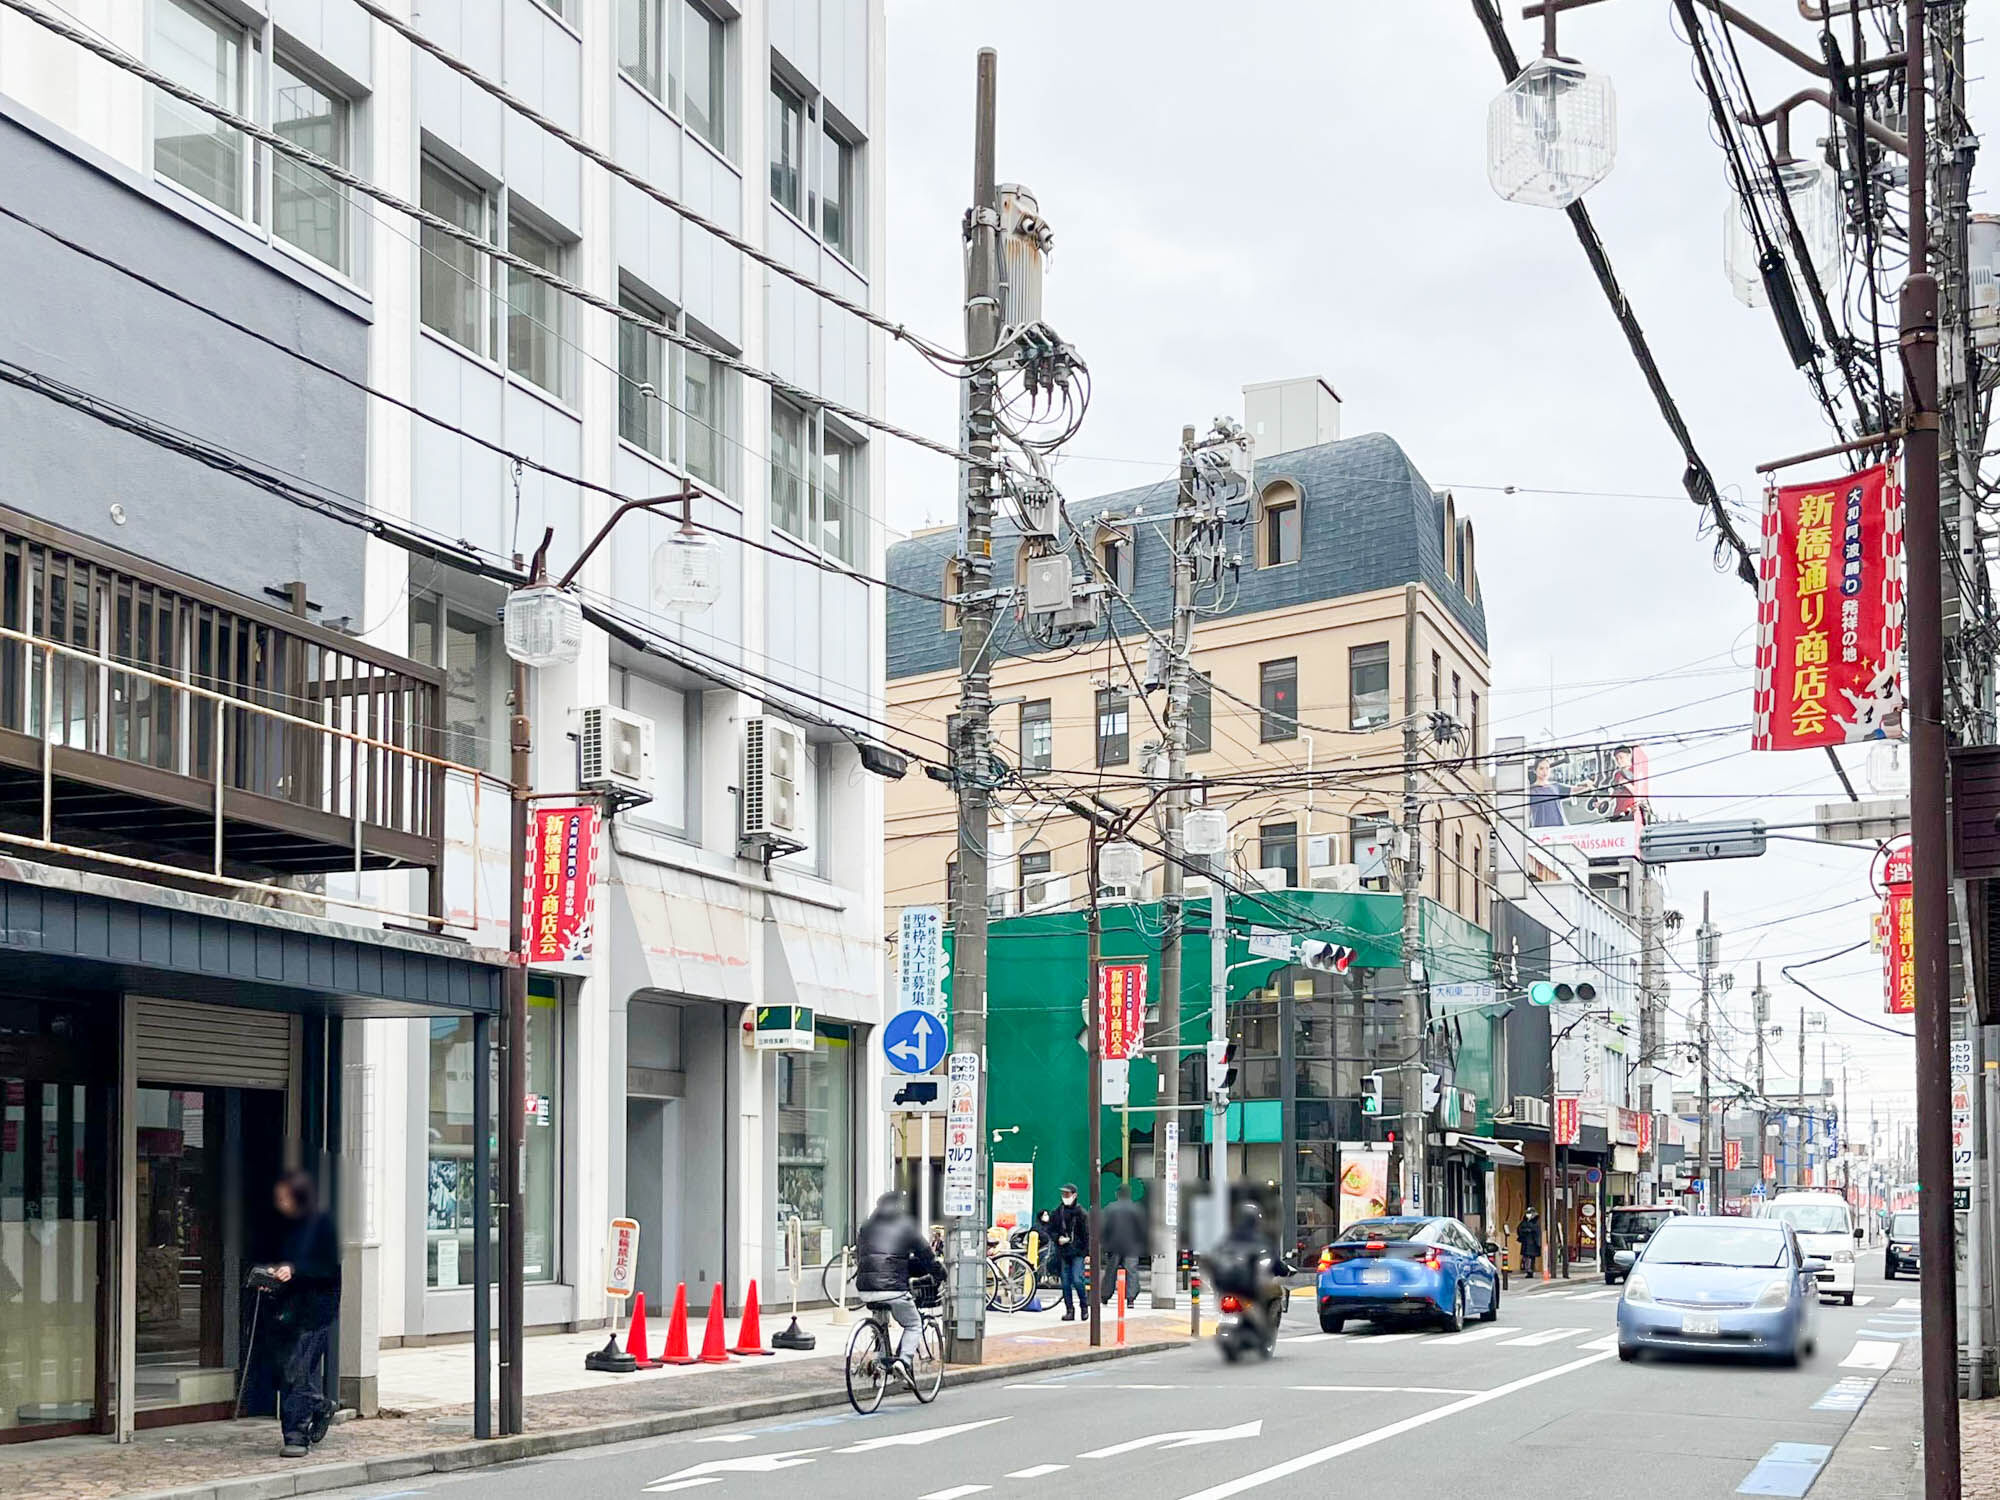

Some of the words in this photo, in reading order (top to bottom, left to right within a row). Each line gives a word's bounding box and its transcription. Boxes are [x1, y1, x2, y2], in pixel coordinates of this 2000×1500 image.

[1791, 491, 1835, 736] 新橋通り商店会
[1841, 599, 1859, 662] 発祥の地
[540, 815, 564, 954] 新橋通り商店会
[1889, 863, 1911, 881] 消
[912, 913, 926, 1006] 型枠大工募集
[948, 1148, 973, 1161] マルワ
